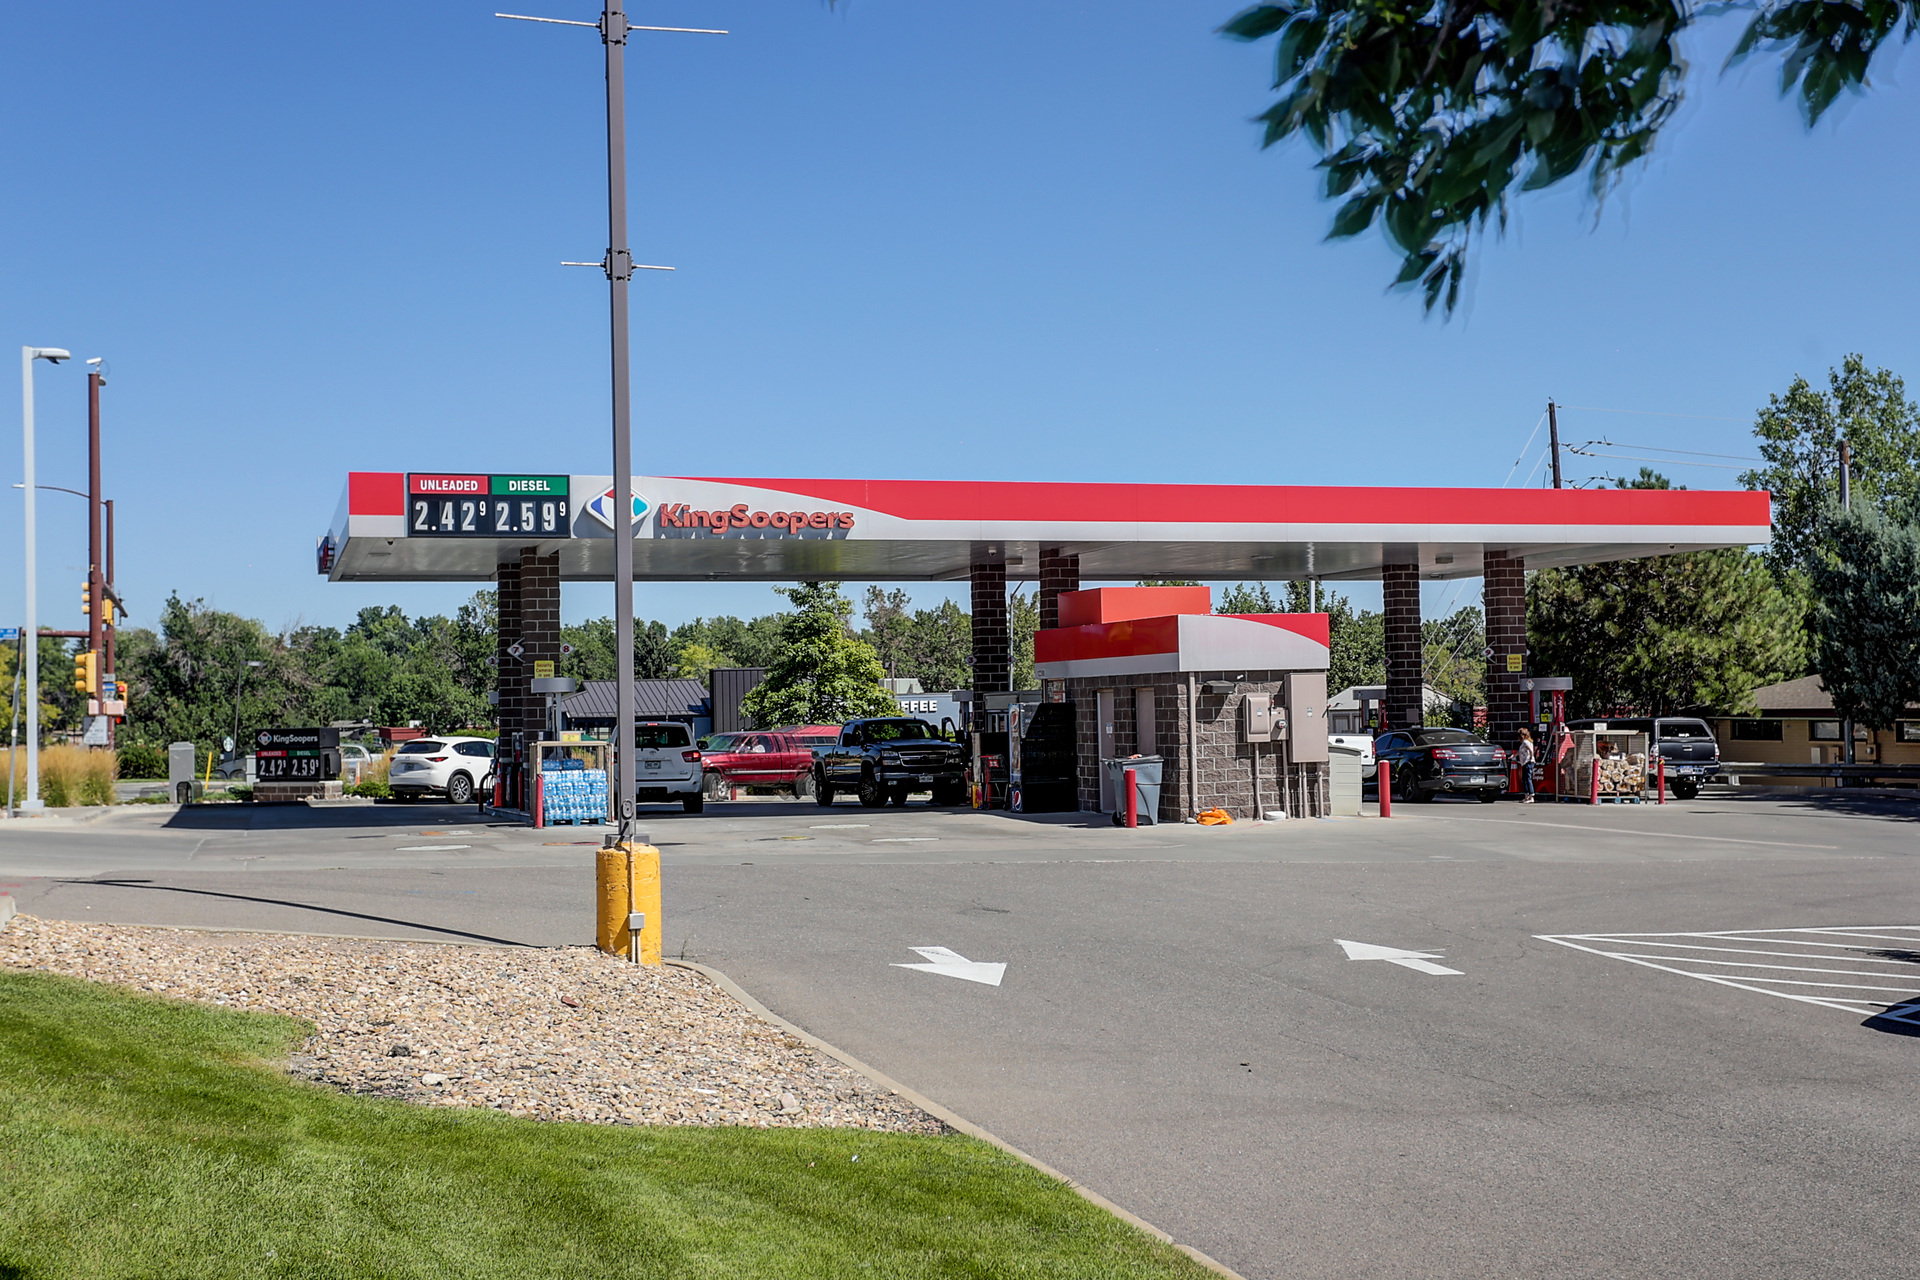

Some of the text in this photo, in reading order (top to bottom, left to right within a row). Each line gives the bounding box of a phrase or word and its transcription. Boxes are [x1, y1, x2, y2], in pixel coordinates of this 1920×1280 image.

[420, 479, 551, 491] UNLEADED DIESEL
[660, 503, 856, 535] KingSoopers
[563, 645, 570, 653] 8
[898, 700, 938, 712] FFEE
[273, 734, 318, 744] KingSoopers
